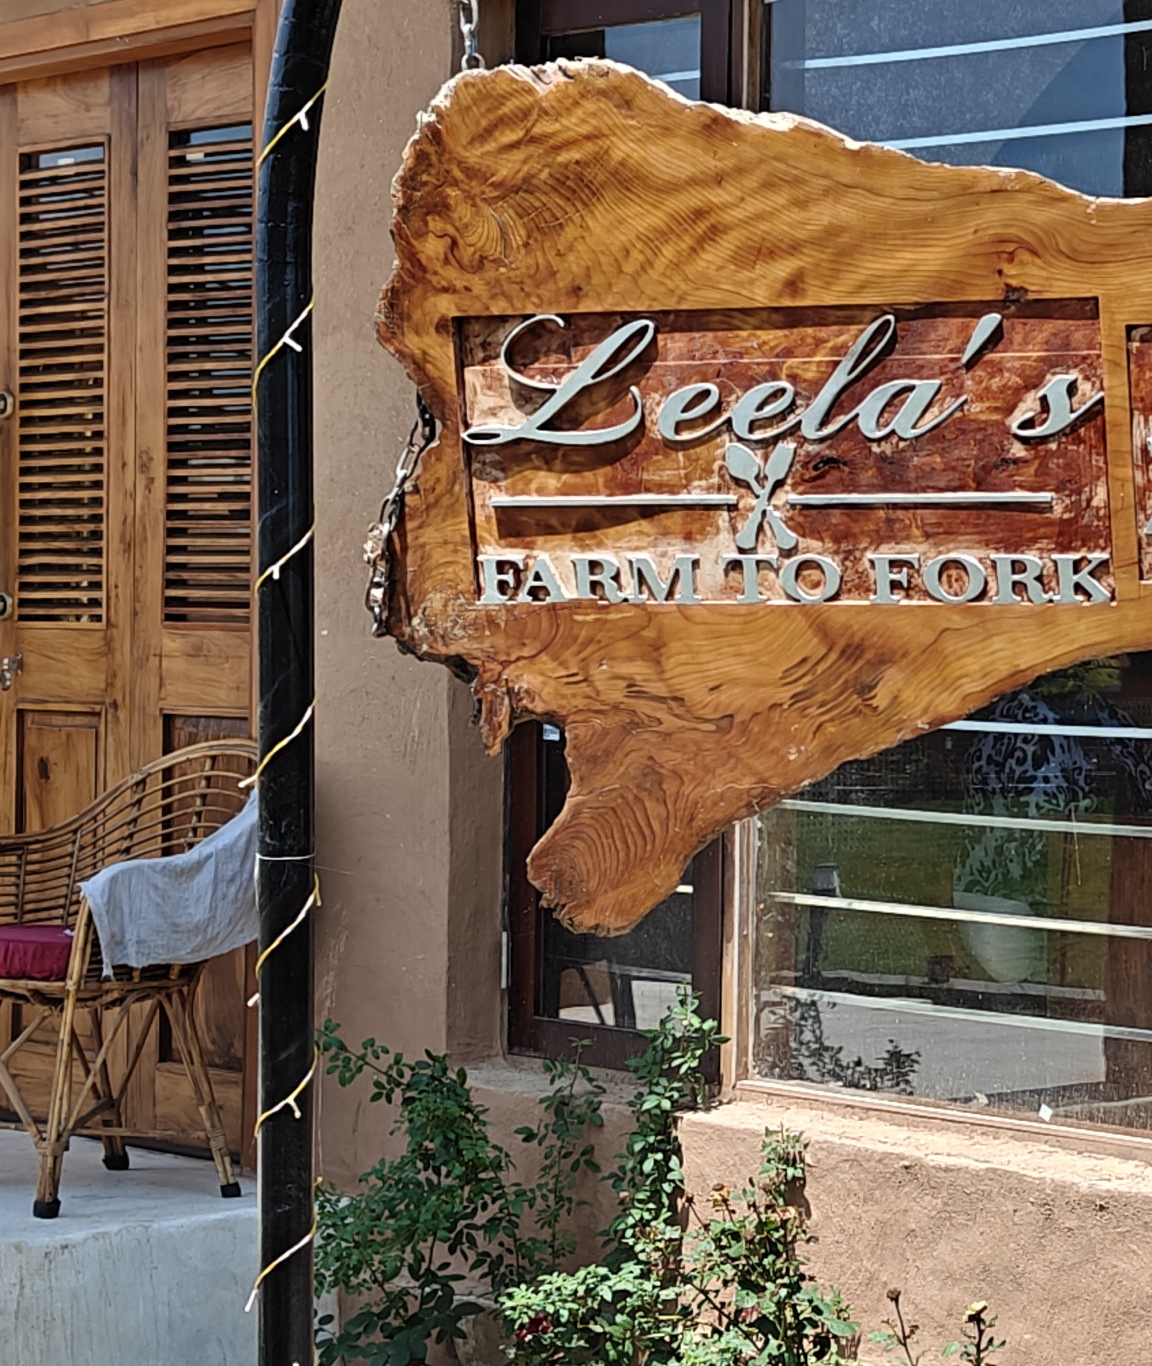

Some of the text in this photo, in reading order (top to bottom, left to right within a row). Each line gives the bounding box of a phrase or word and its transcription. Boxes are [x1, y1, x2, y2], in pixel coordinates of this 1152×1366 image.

[461, 313, 1105, 445] Leela's
[476, 553, 1112, 605] FARM TO FORK
